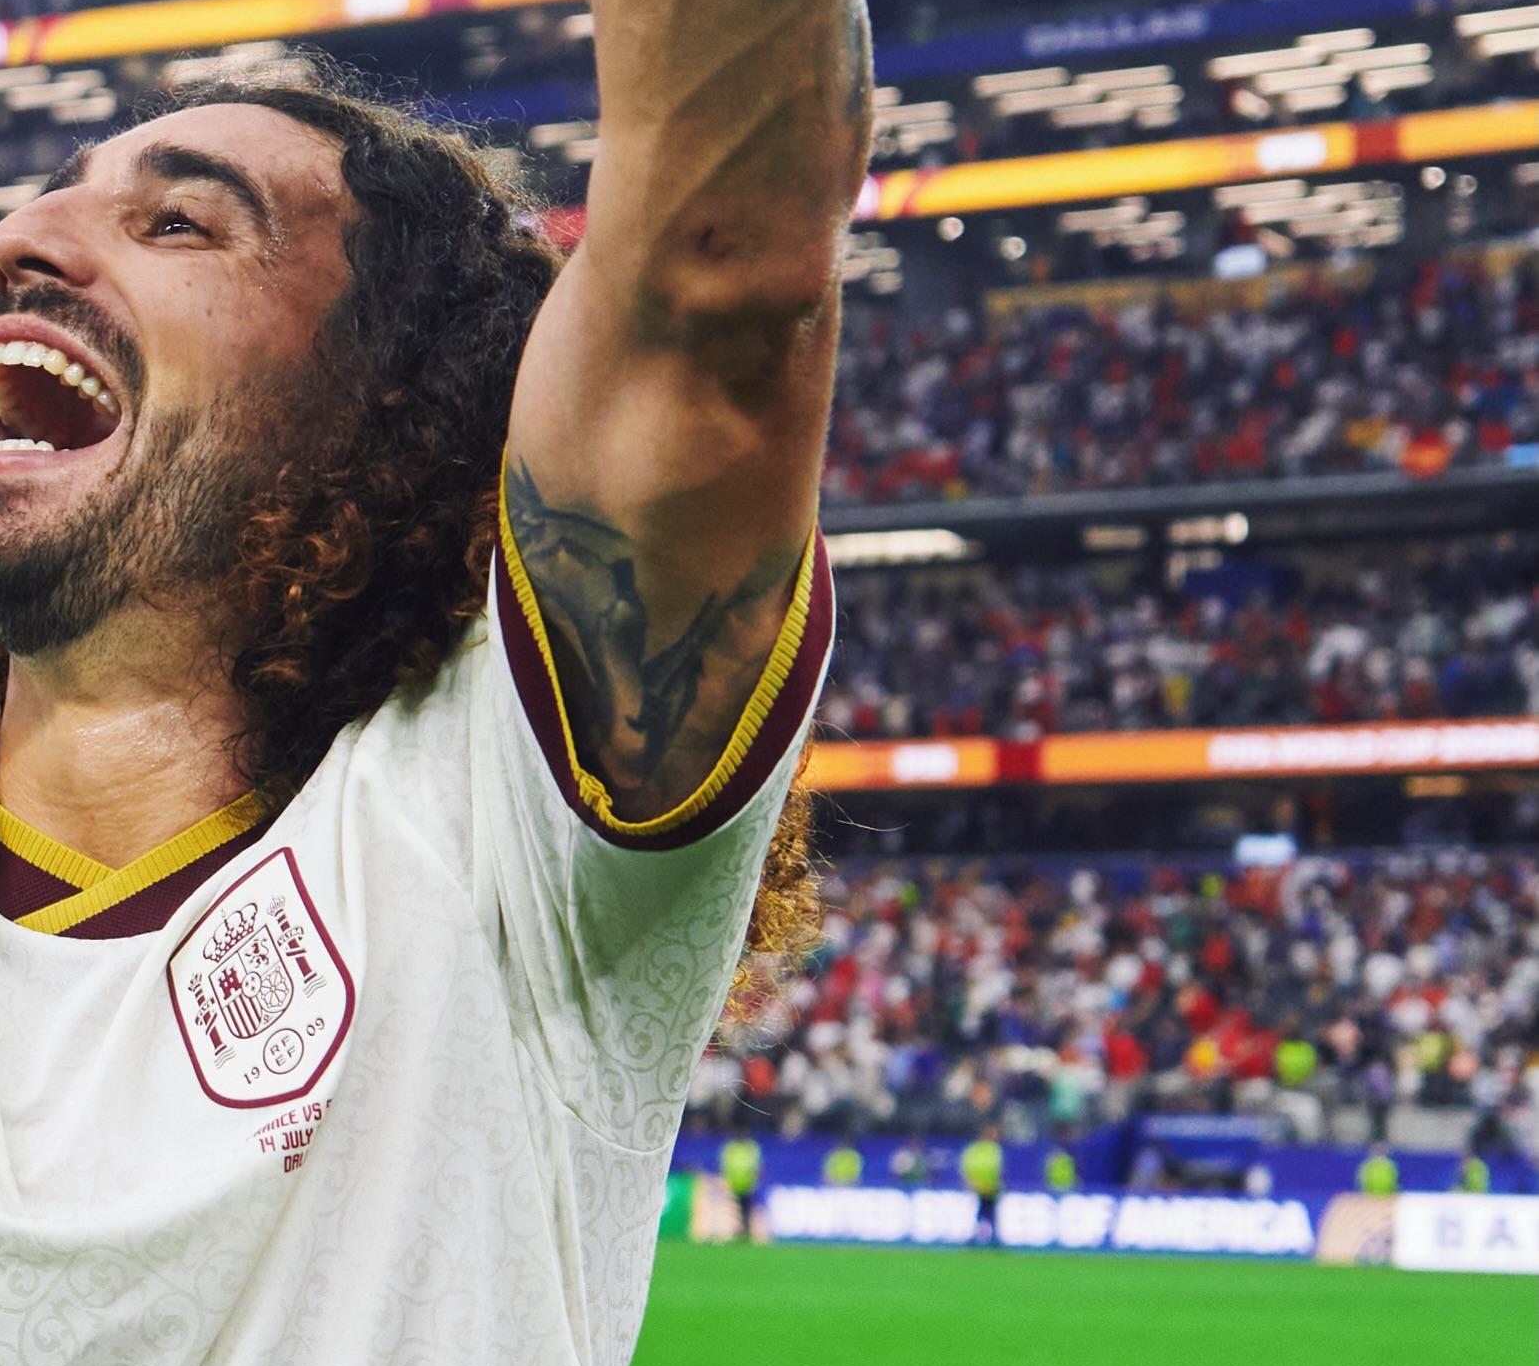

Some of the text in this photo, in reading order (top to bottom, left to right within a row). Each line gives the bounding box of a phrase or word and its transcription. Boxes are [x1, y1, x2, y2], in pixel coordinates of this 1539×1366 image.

[306, 1017, 325, 1037] 09
[243, 1066, 261, 1085] 19
[302, 1102, 322, 1122] VS
[259, 1127, 313, 1153] 14 JULY
